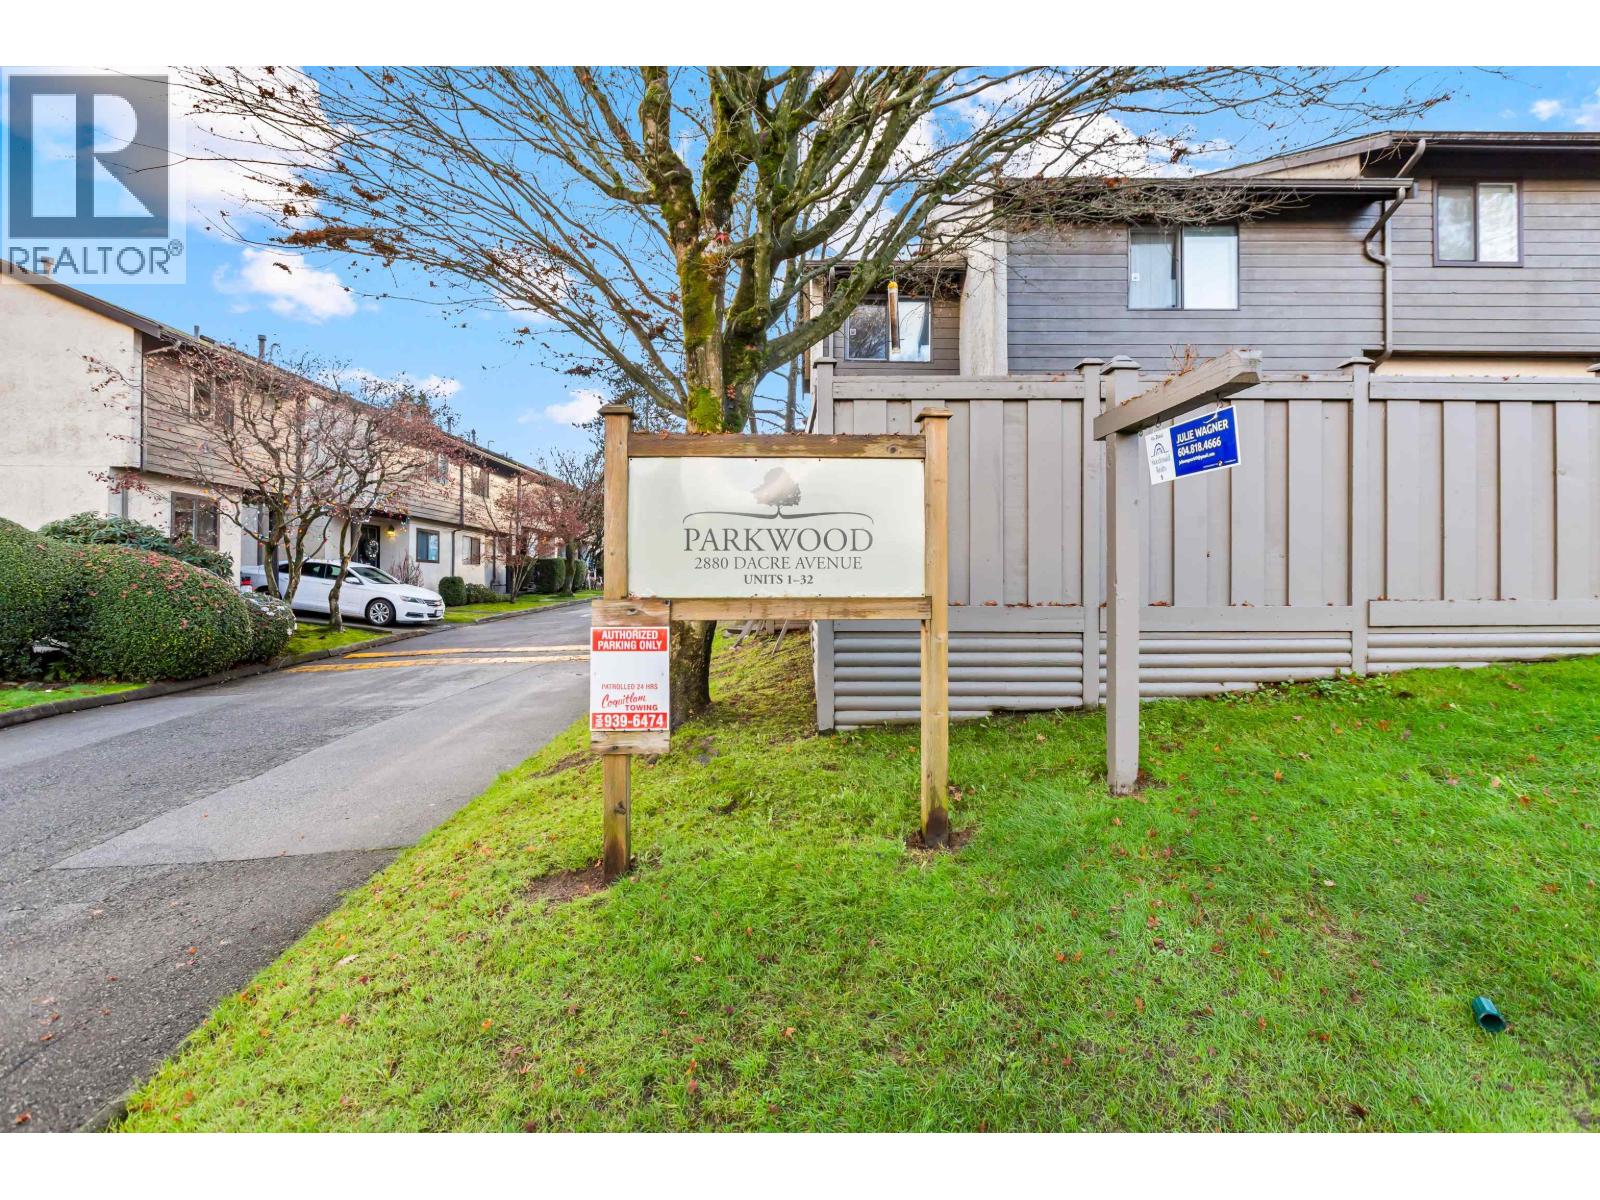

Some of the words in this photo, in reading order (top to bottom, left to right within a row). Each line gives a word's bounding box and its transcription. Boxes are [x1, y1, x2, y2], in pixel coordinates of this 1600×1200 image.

[1176, 430, 1195, 444] JULIE
[1195, 419, 1229, 438] WAGNER
[1177, 436, 1222, 457] 604.818.4666
[683, 528, 873, 551] PARKWOOD
[694, 556, 729, 570] 2880
[734, 556, 791, 570] DACRE
[795, 556, 863, 570] AVENUE
[744, 574, 783, 585] UNITS
[601, 630, 658, 640] AUTHORIZED
[597, 640, 637, 650] PARKING
[639, 640, 663, 650] ONLY
[601, 692, 647, 709] Coquitlam
[604, 714, 664, 728] 939-6474
